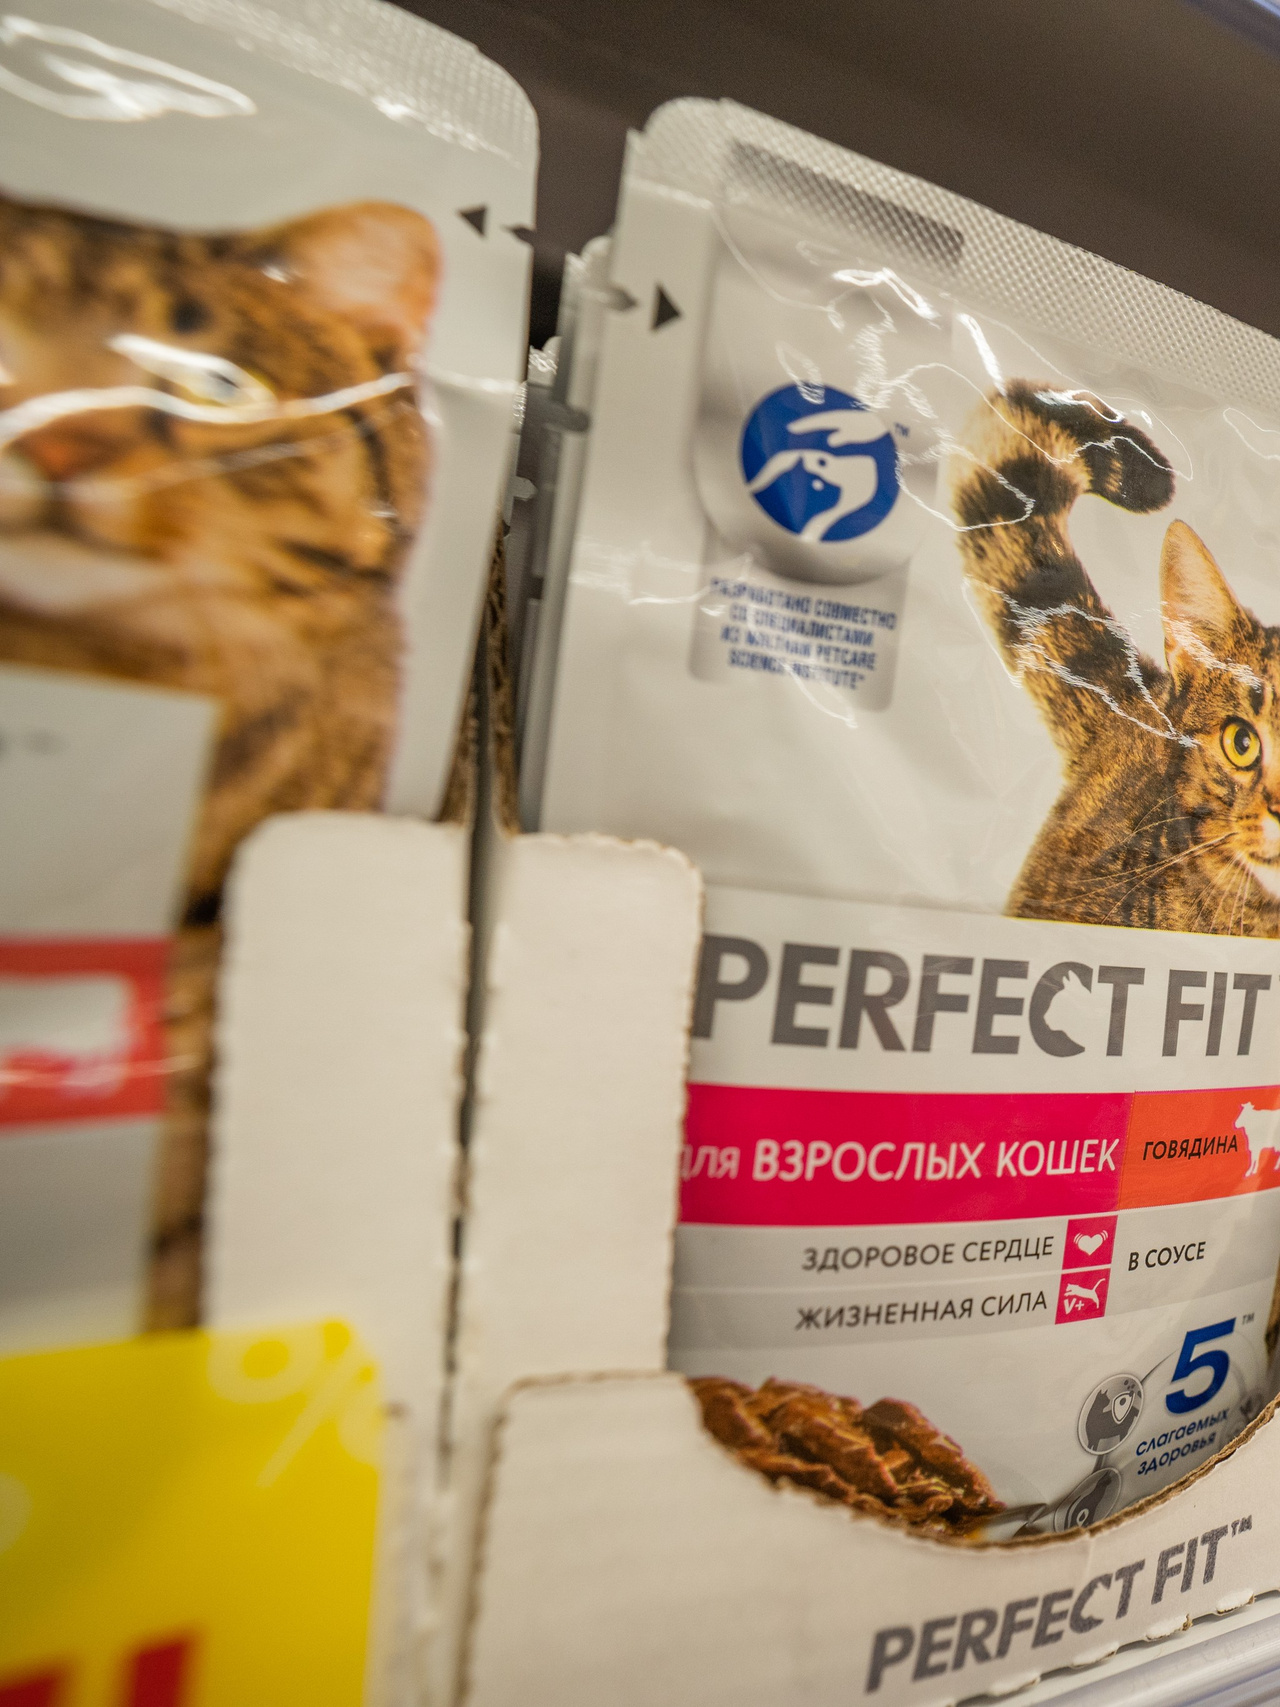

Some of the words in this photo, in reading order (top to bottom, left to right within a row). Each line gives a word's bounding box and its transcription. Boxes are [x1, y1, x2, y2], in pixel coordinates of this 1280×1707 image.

[814, 597, 898, 630] СОВМЕСТНО
[691, 932, 1145, 1057] PERFECT
[752, 1138, 985, 1182] ВЗРОСЛЫХ
[996, 1138, 1120, 1178] КОШЕК
[1141, 1134, 1239, 1162] ГОВЯДИНА
[801, 1243, 956, 1273] ЗДОРОВОЕ
[962, 1235, 1055, 1265] СЕРДЦЕ
[1127, 1252, 1140, 1272] В
[1143, 1241, 1207, 1269] СОУСЕ
[795, 1297, 975, 1332] ЖИЗНЕННАЯ
[980, 1290, 1048, 1317] СИЛА
[1135, 1408, 1230, 1457] слагаемых
[1137, 1432, 1217, 1476] здоровья
[865, 1558, 1145, 1695] PERFECT
